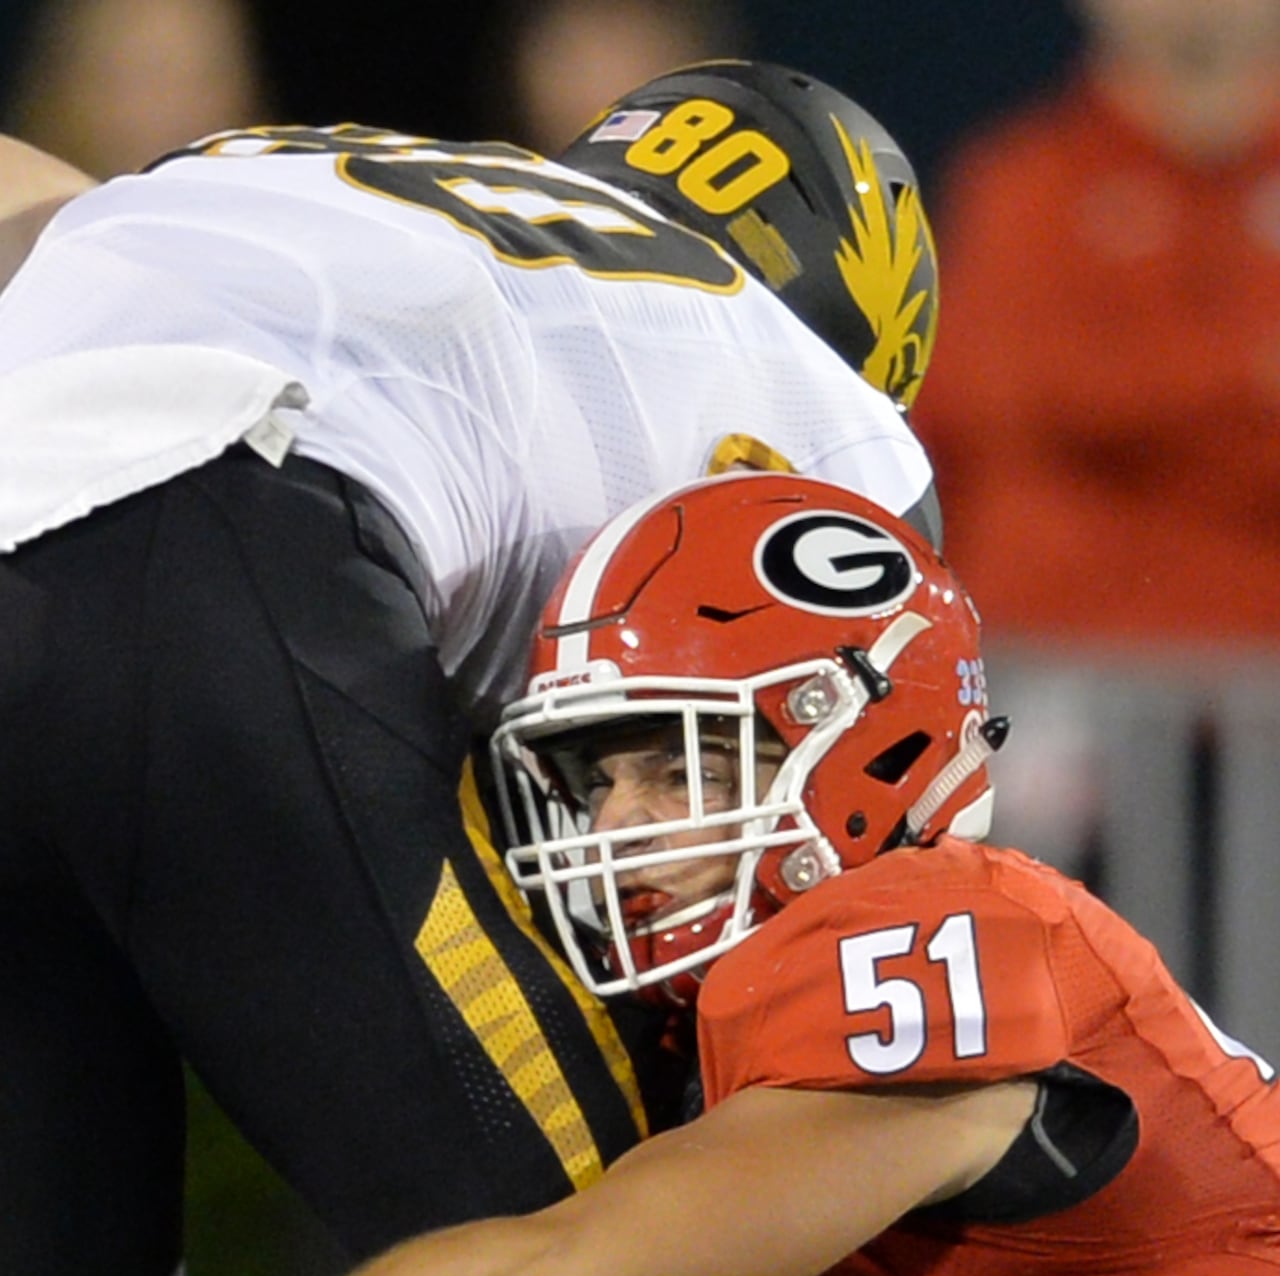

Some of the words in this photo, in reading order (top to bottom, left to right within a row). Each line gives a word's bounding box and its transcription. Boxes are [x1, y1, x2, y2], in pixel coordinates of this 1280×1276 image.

[625, 99, 789, 214] 80
[761, 515, 913, 610] G
[838, 910, 987, 1076] 51
